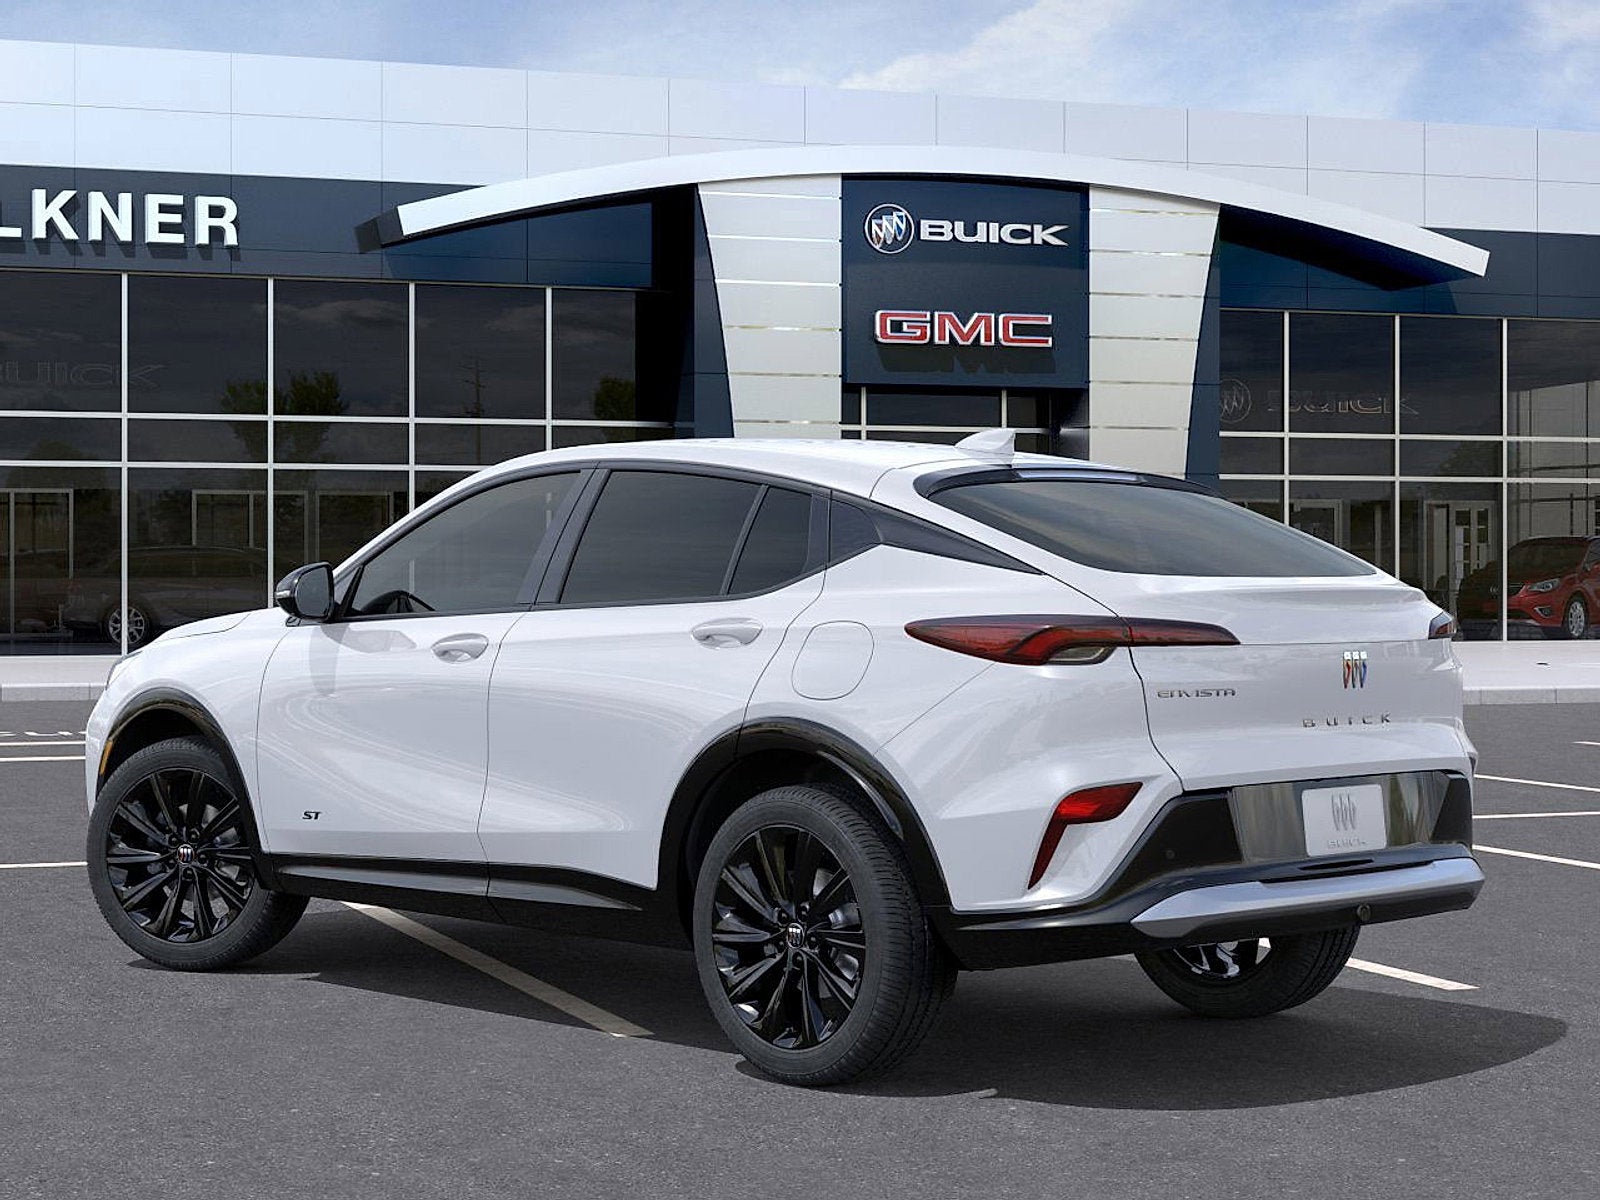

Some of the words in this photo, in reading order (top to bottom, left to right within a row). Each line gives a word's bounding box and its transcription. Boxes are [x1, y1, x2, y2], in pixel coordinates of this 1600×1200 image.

[920, 219, 1069, 247] BUICK
[875, 309, 1053, 348] GMC
[0, 360, 167, 389] UICK
[1157, 688, 1236, 698] ENVISTA
[1302, 712, 1391, 728] BUICK
[302, 811, 322, 820] ST
